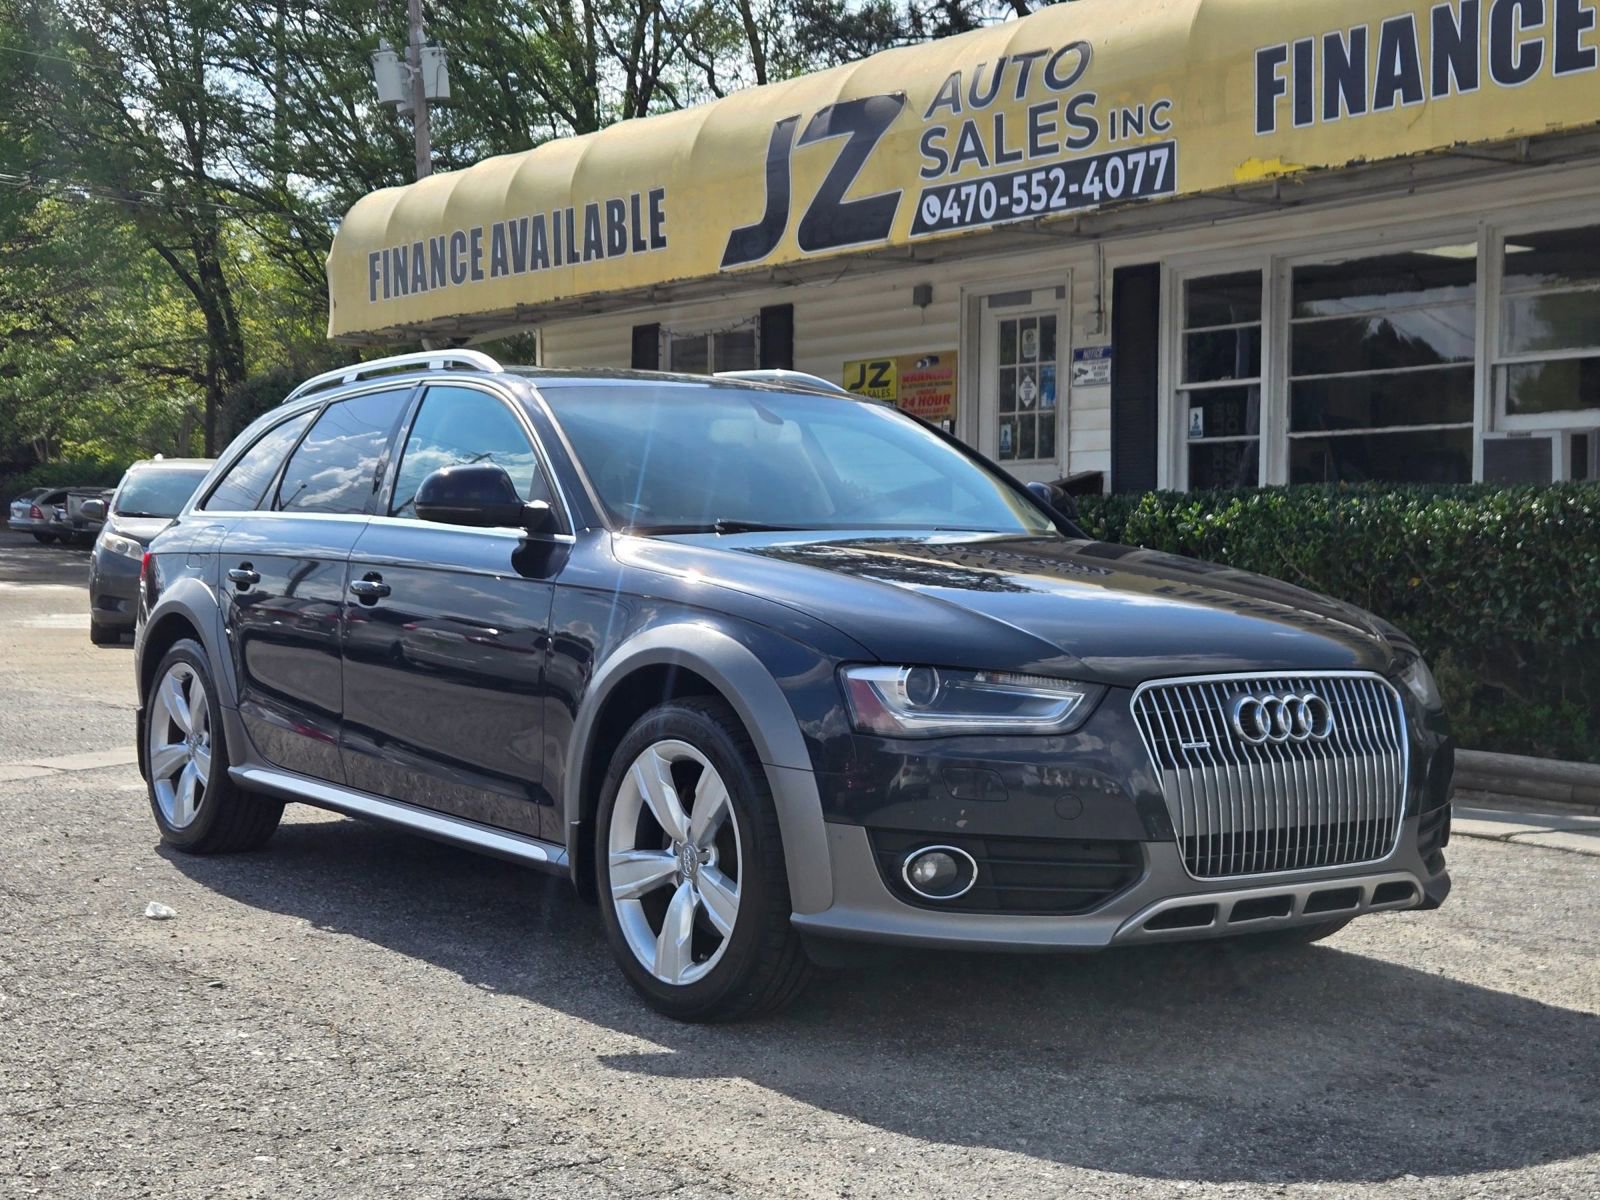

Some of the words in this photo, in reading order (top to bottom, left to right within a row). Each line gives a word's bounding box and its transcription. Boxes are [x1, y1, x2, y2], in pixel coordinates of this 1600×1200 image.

[923, 40, 1093, 121] AUTO
[1255, 0, 1598, 135] FINANCE
[919, 92, 1099, 180] SALES
[1108, 99, 1173, 142] INC
[720, 91, 906, 268] JZ
[942, 150, 1170, 224] 470-552-4077
[369, 226, 484, 303] FINANCE
[490, 187, 667, 279] AVAILABLE
[849, 361, 890, 390] JZ
[918, 394, 951, 407] HOUR
